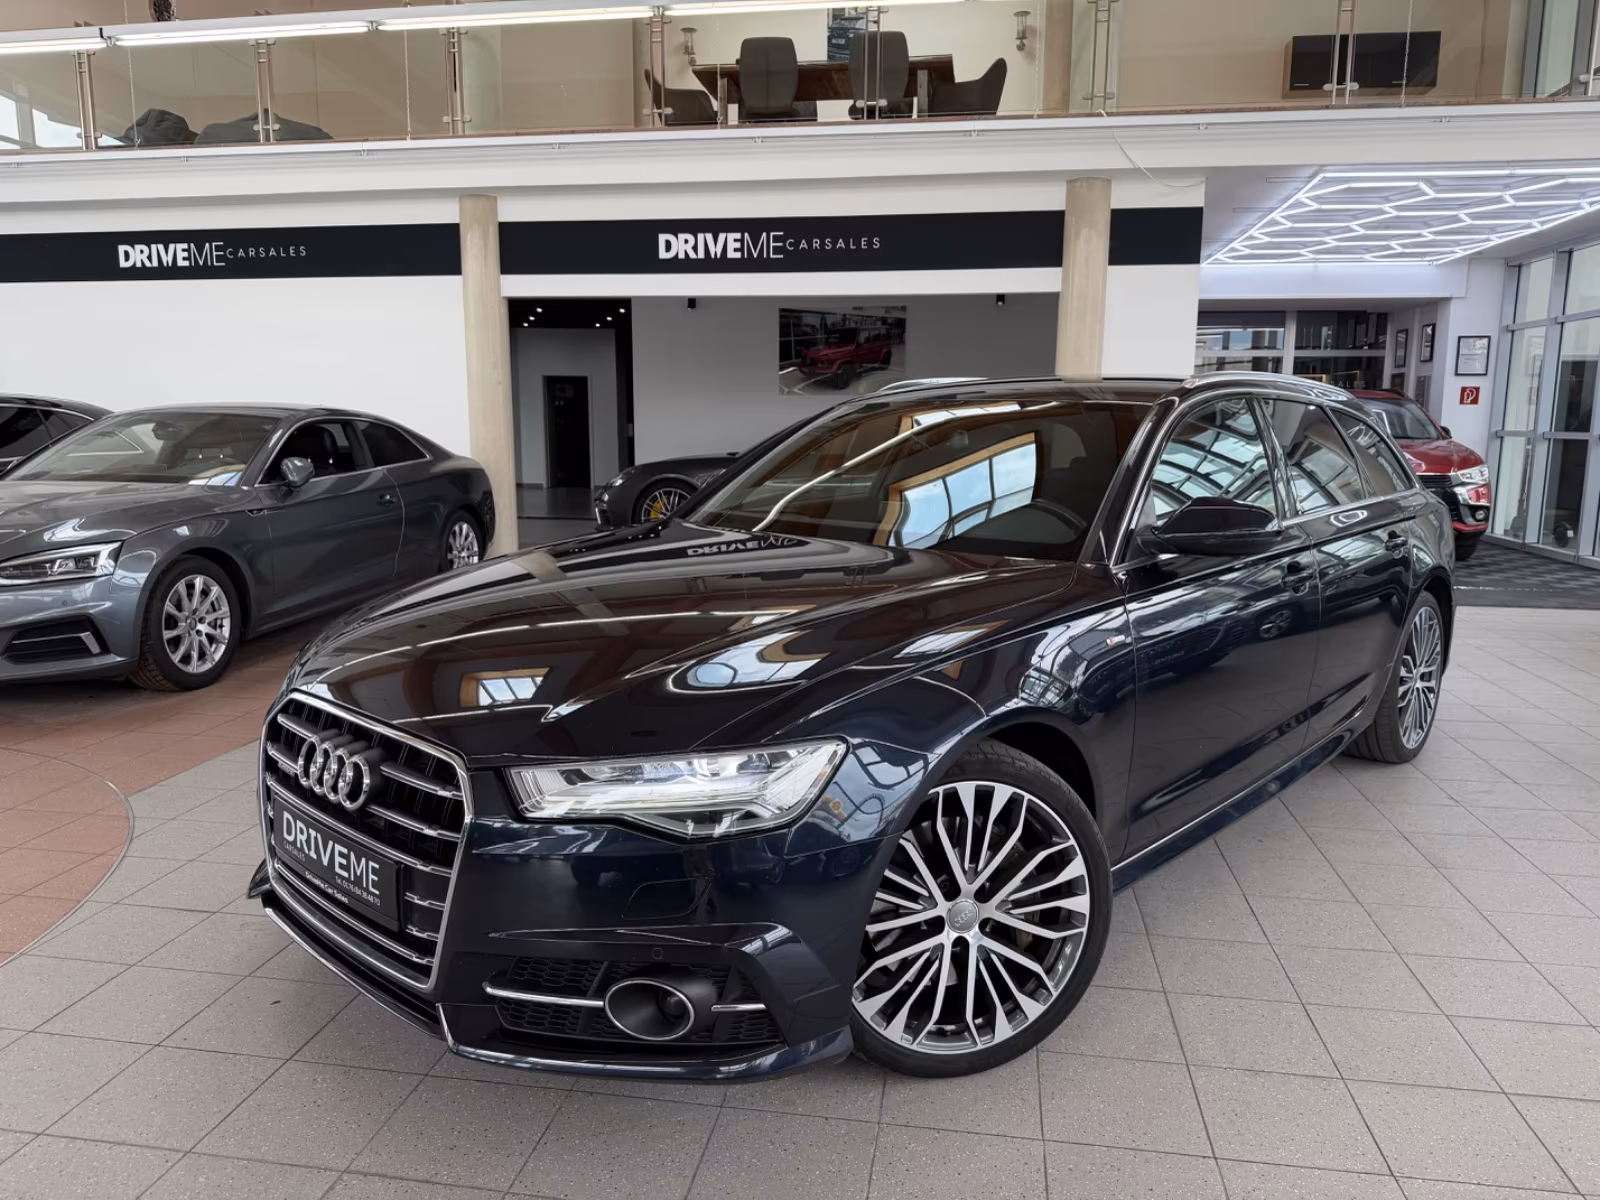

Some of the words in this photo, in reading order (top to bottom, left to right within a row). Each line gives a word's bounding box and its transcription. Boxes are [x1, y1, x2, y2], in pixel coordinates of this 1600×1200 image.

[117, 242, 226, 268] DRIVEME
[226, 245, 307, 259] CARSALES
[658, 231, 784, 260] DRIVEME
[785, 237, 881, 250] CARSALES
[282, 810, 380, 895] DRIVEME
